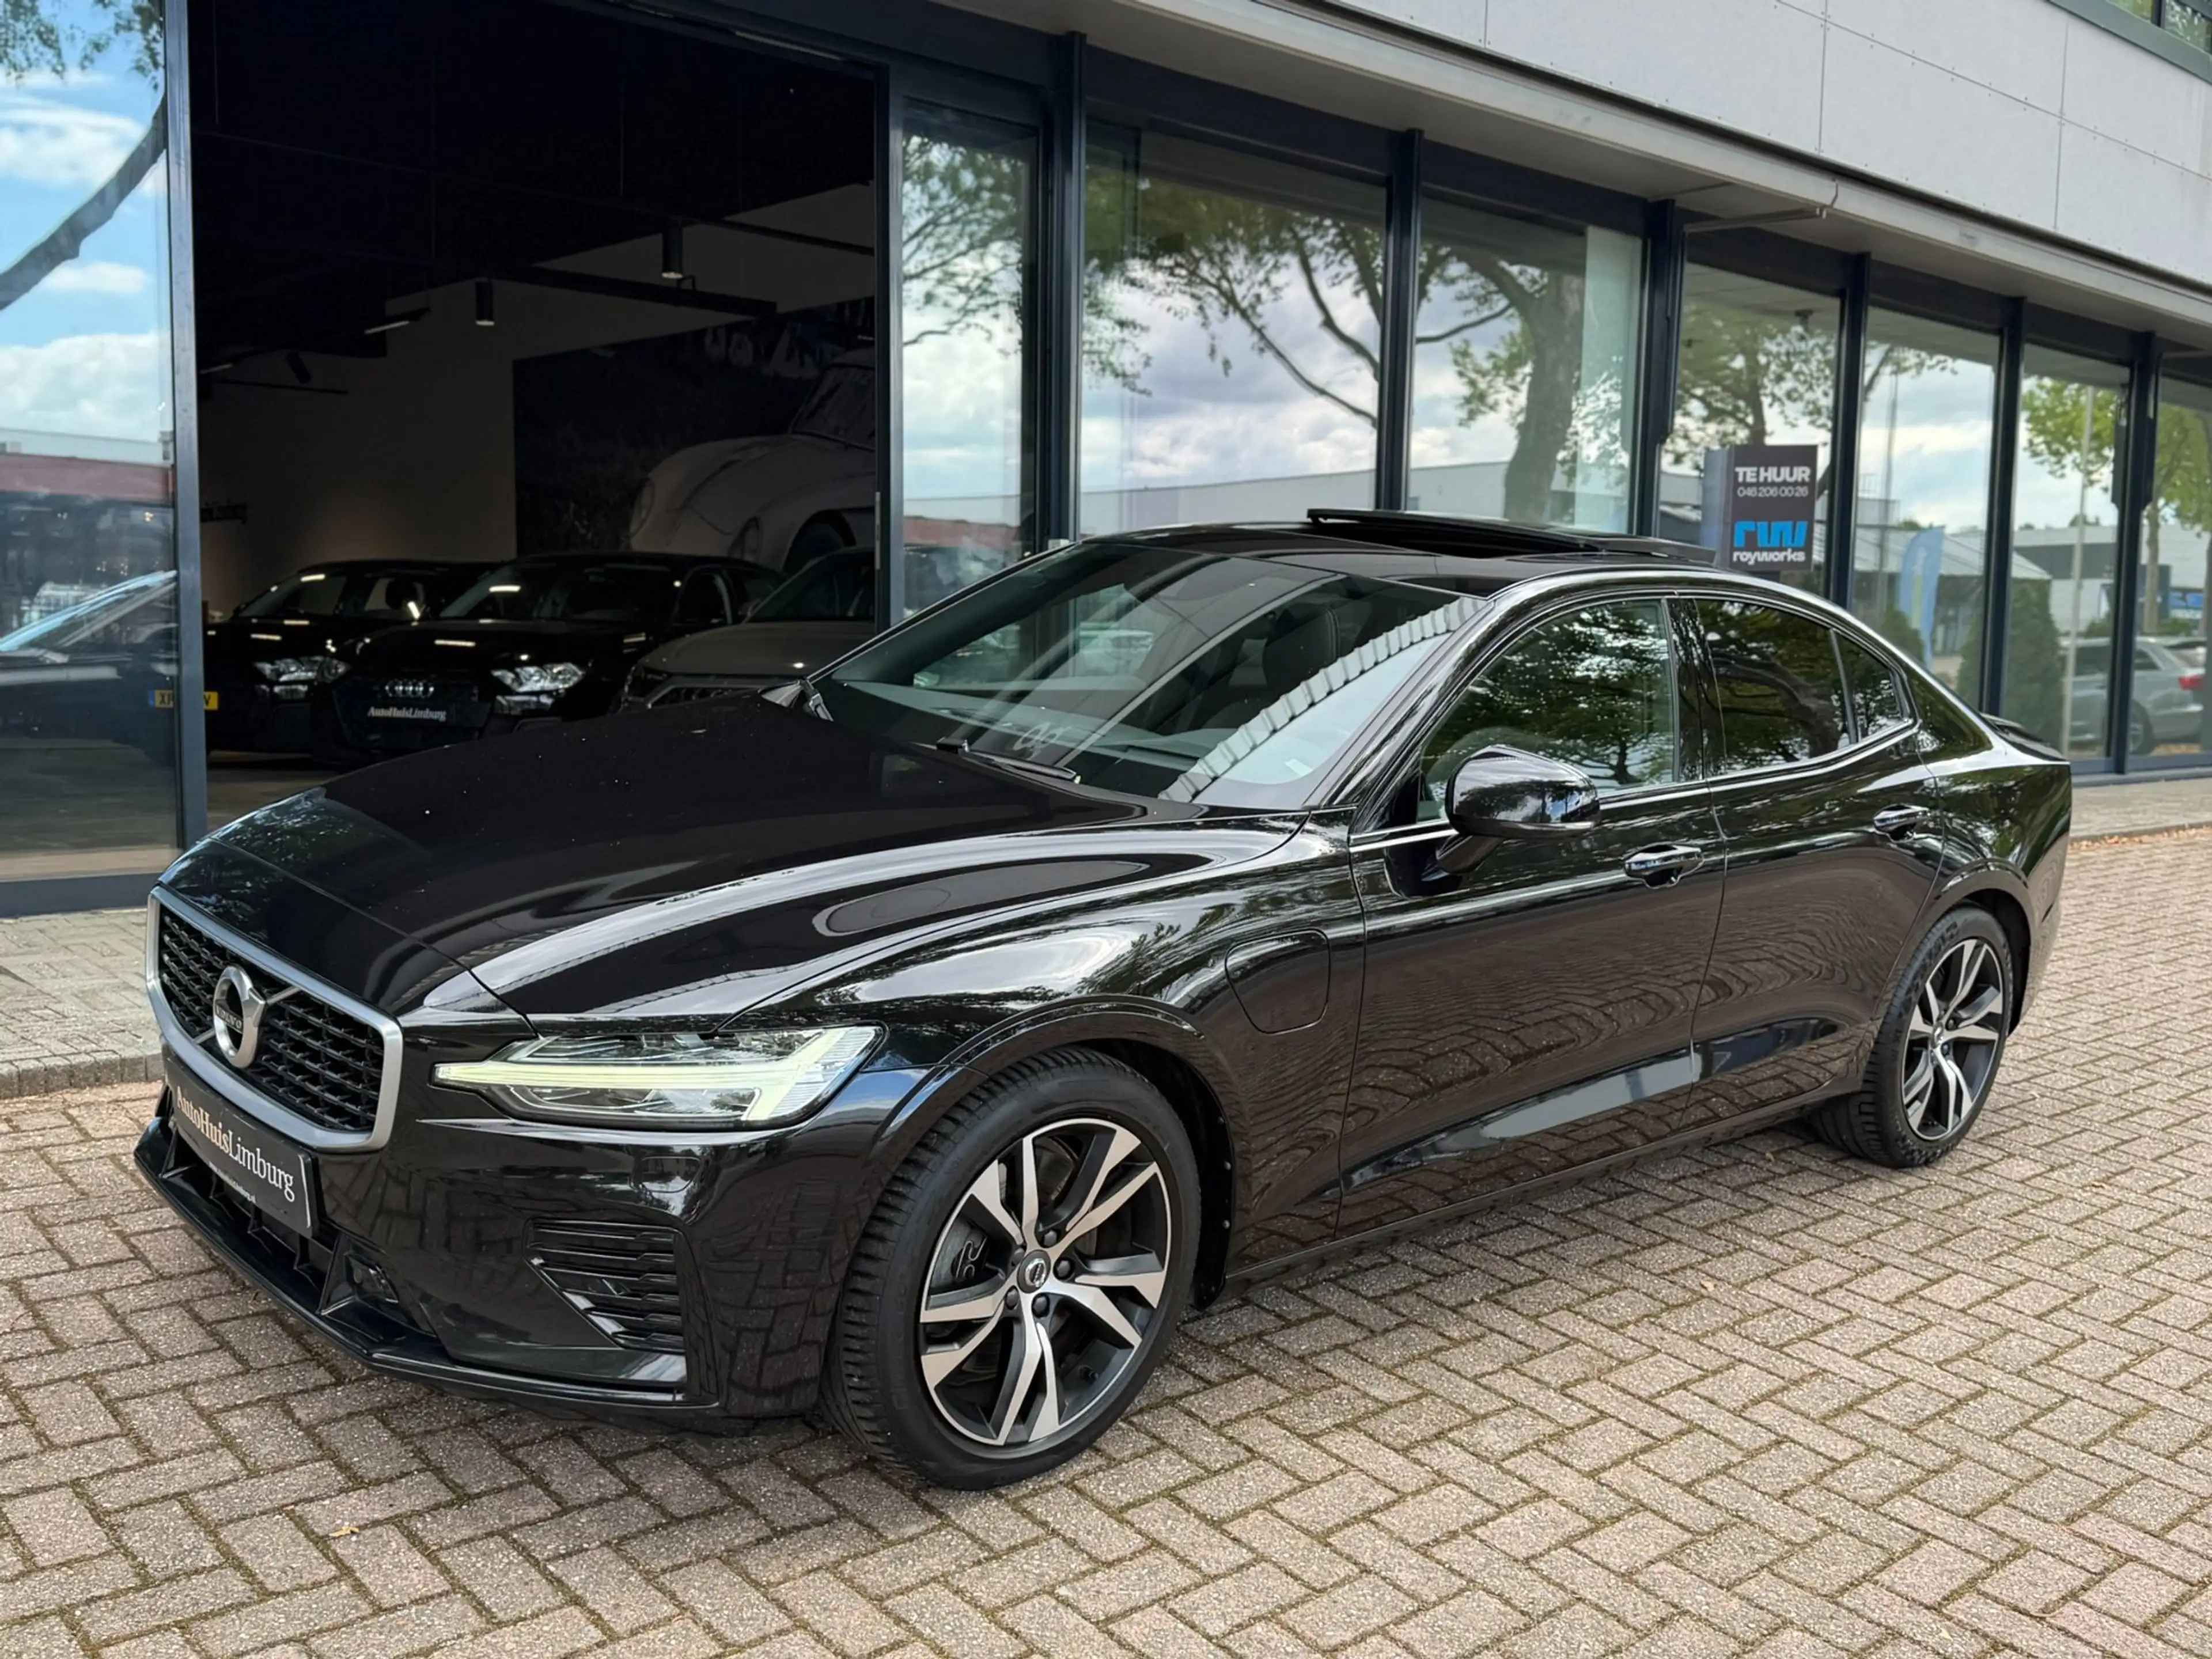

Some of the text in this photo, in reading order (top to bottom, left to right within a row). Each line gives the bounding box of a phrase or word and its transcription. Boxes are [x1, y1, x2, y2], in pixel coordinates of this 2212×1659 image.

[1734, 466, 1811, 483] TE HUUR
[1779, 486, 1794, 497] 00
[1733, 548, 1806, 565] royworks
[366, 706, 448, 722] AutoHuisLimburg
[215, 1005, 243, 1029] VOLVO
[177, 1085, 296, 1203] AutoHuisLimburg
